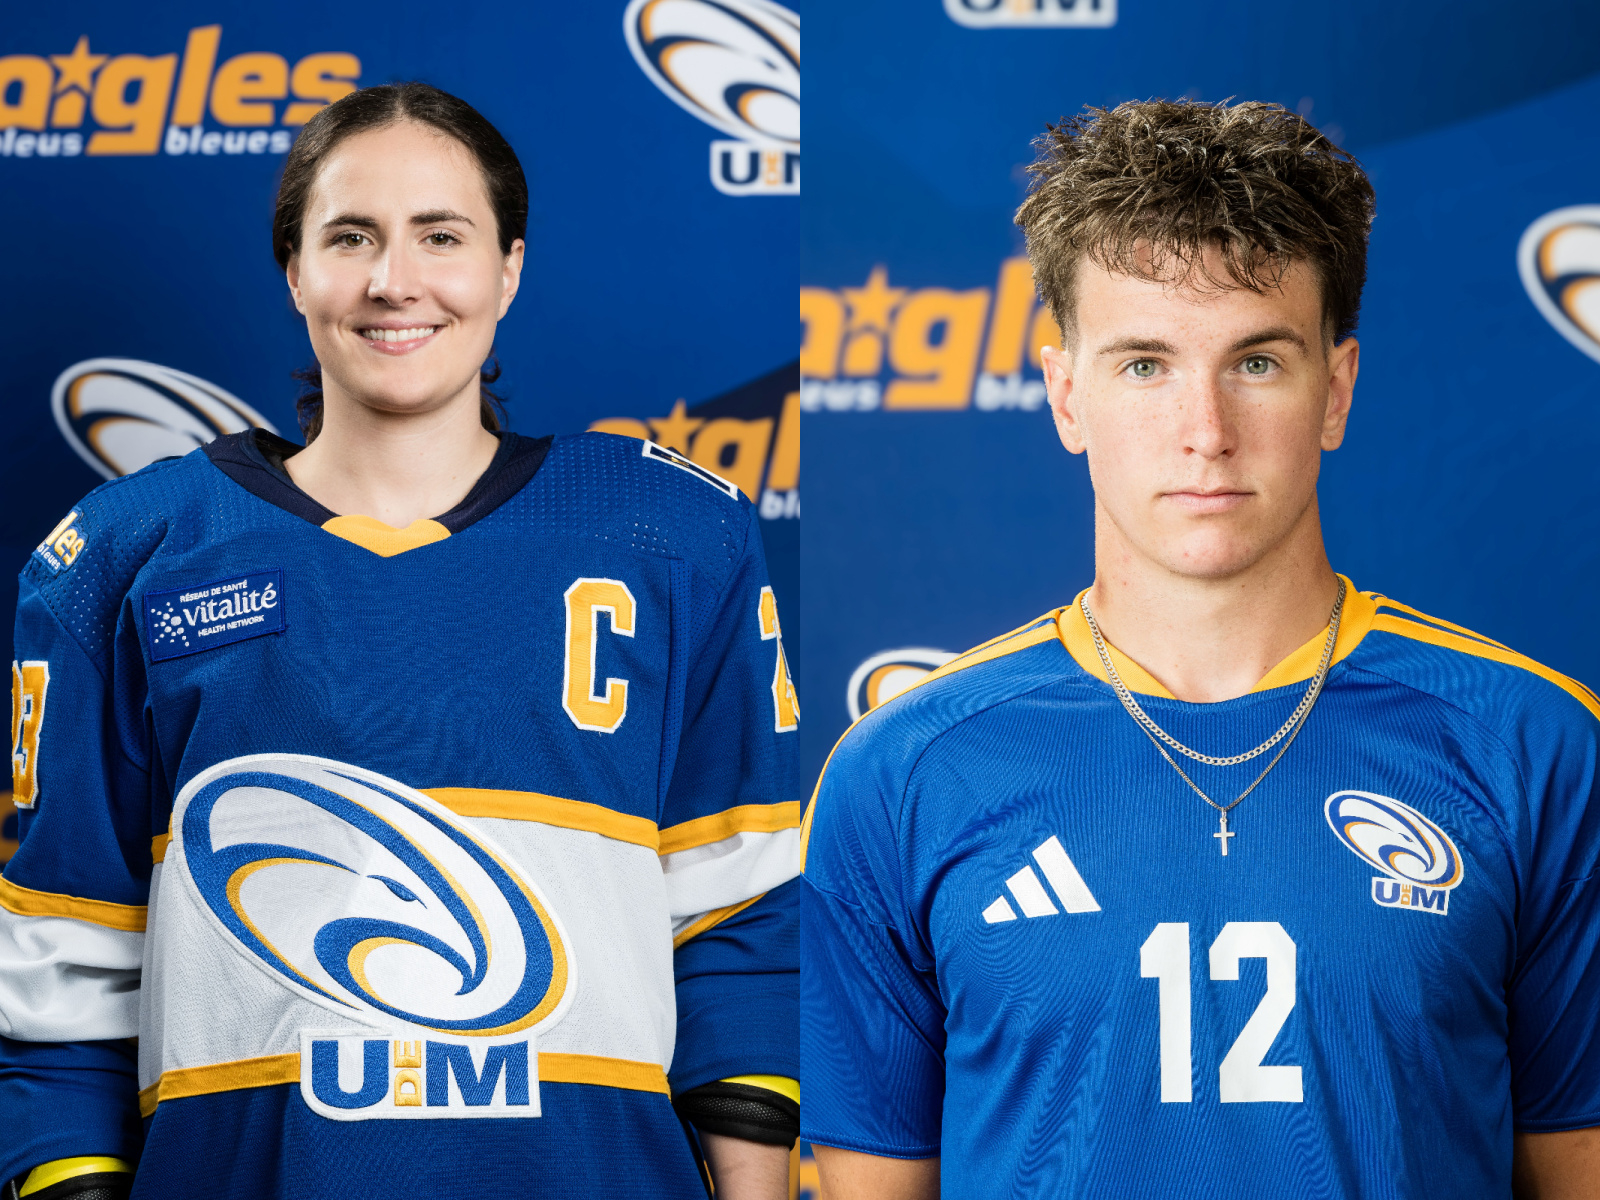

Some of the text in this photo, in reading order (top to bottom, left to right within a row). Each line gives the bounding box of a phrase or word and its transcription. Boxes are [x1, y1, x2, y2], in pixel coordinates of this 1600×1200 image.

[0, 126, 293, 157] leus bleues
[179, 579, 248, 603] RÉSEAU DE SANTÉ
[198, 614, 265, 637] HEALTH NETWORK
[562, 577, 636, 734] C
[1140, 921, 1303, 1103] 12
